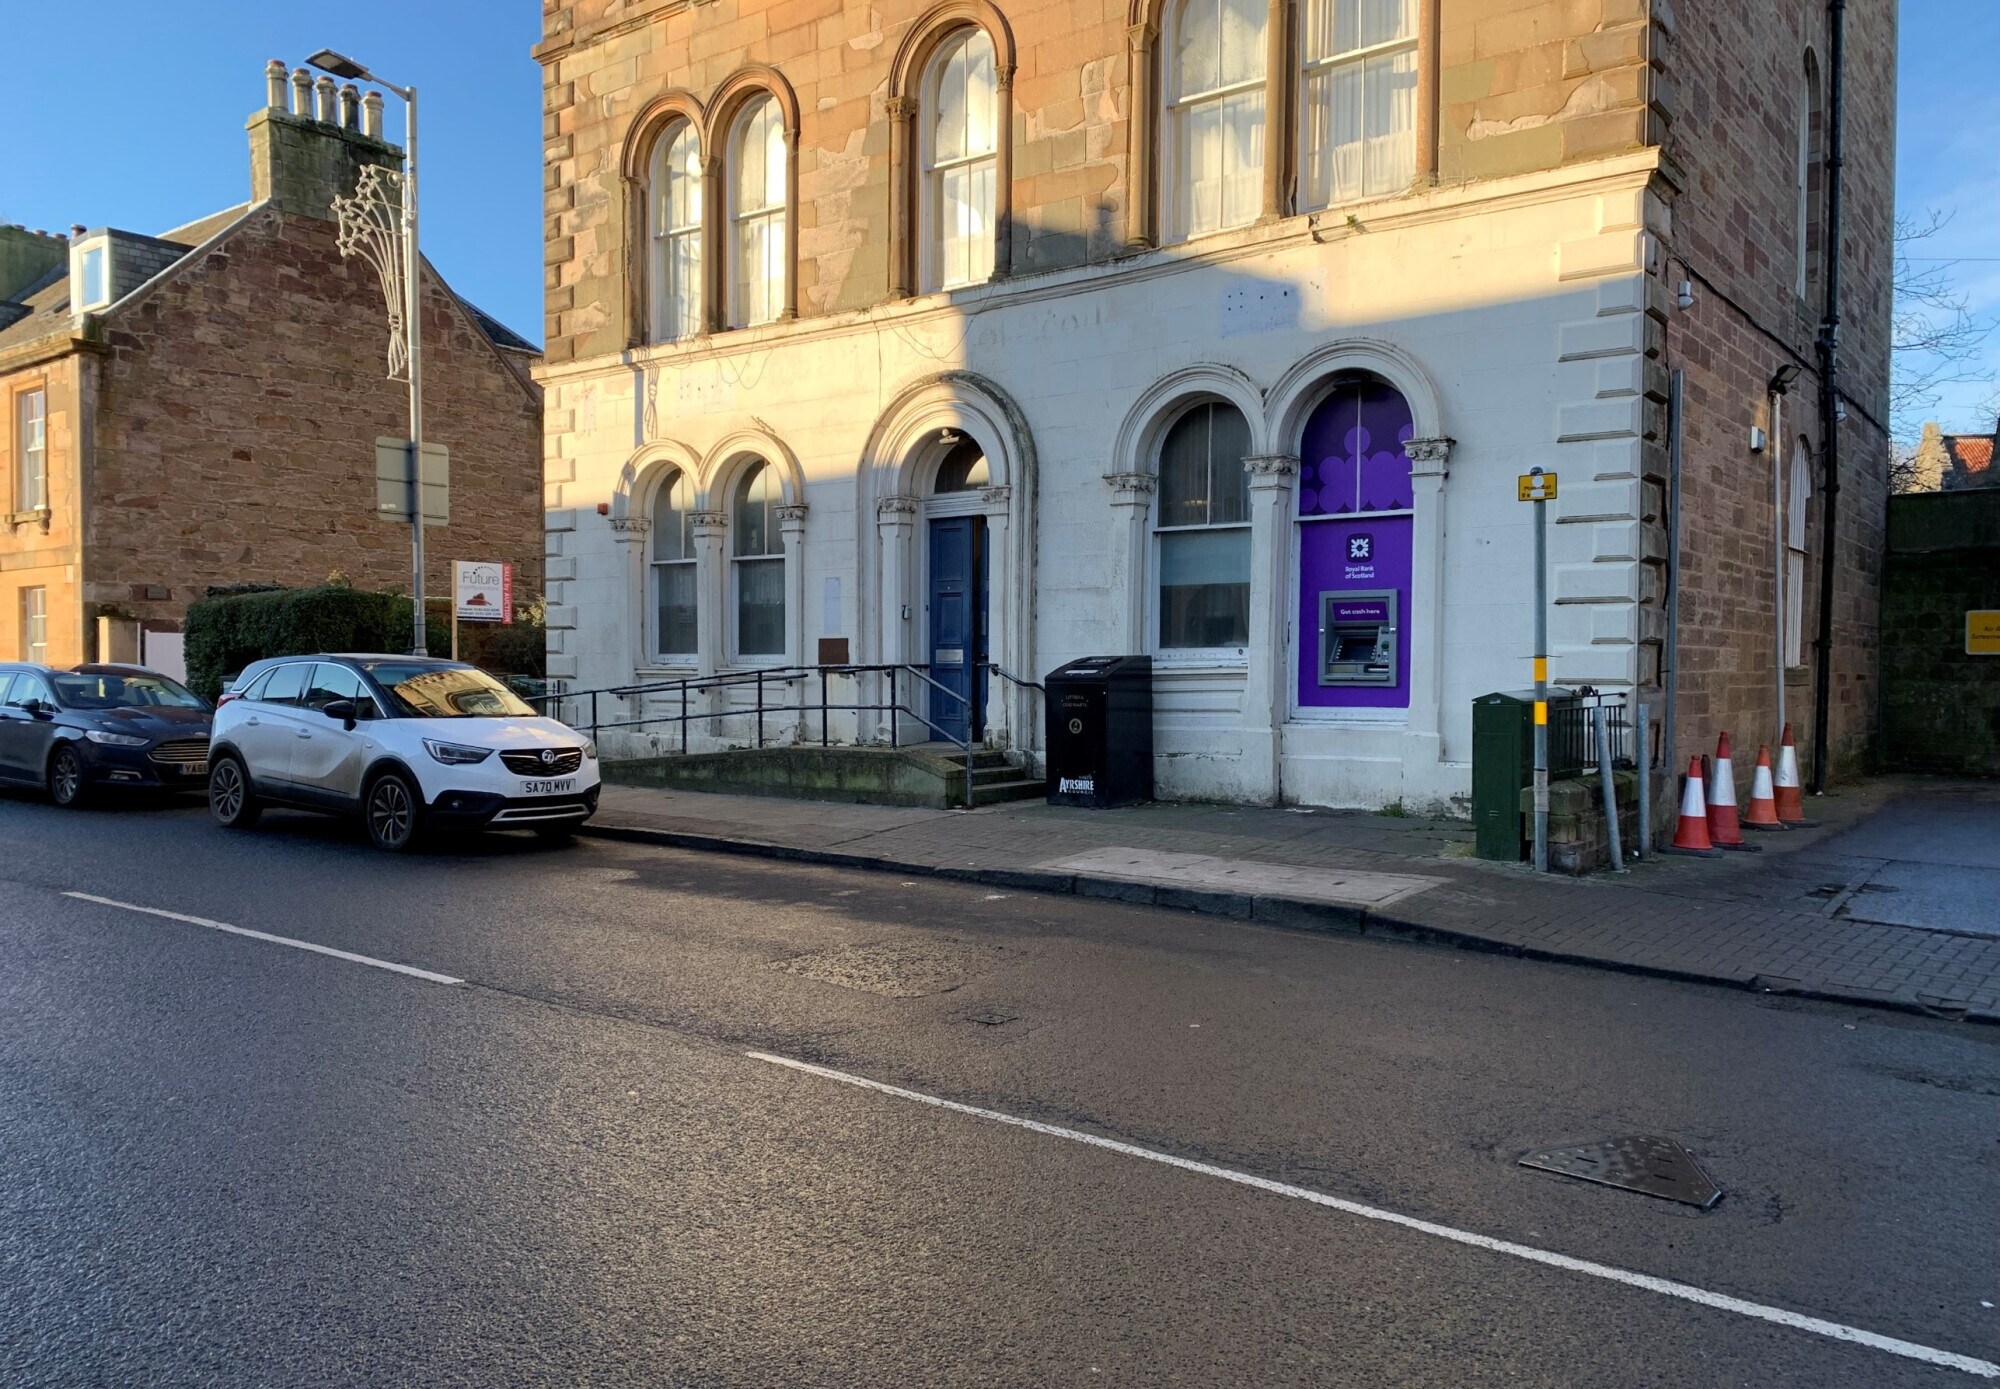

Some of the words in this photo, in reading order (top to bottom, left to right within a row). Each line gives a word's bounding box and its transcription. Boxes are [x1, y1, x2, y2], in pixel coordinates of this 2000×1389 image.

[1344, 566, 1360, 574] Royal
[462, 571, 500, 586] Future
[526, 782, 552, 793] SA70
[554, 780, 571, 792] MVV
